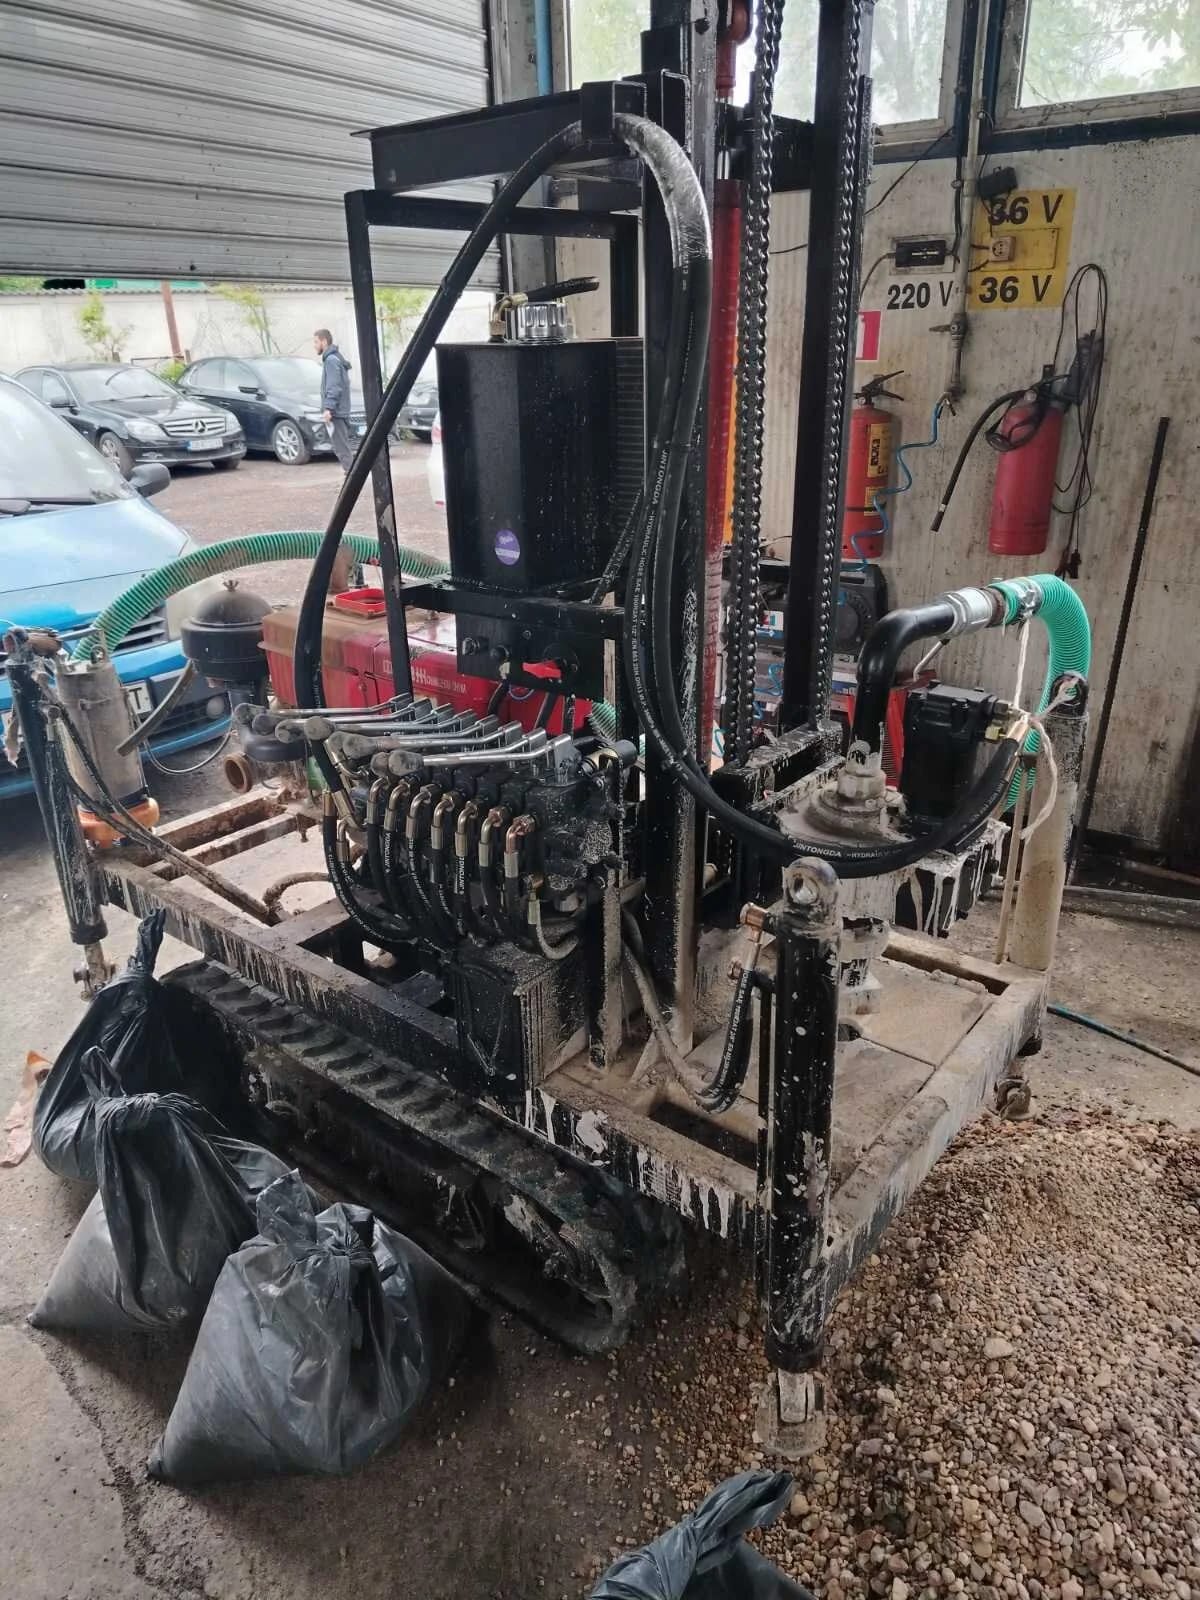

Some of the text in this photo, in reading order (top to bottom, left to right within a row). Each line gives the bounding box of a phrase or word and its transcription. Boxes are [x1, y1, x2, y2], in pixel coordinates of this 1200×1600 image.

[988, 194, 1063, 226] 36 V
[887, 281, 954, 310] 220 V
[978, 275, 1052, 303] 36 V
[792, 841, 842, 858] JINTONGDA
